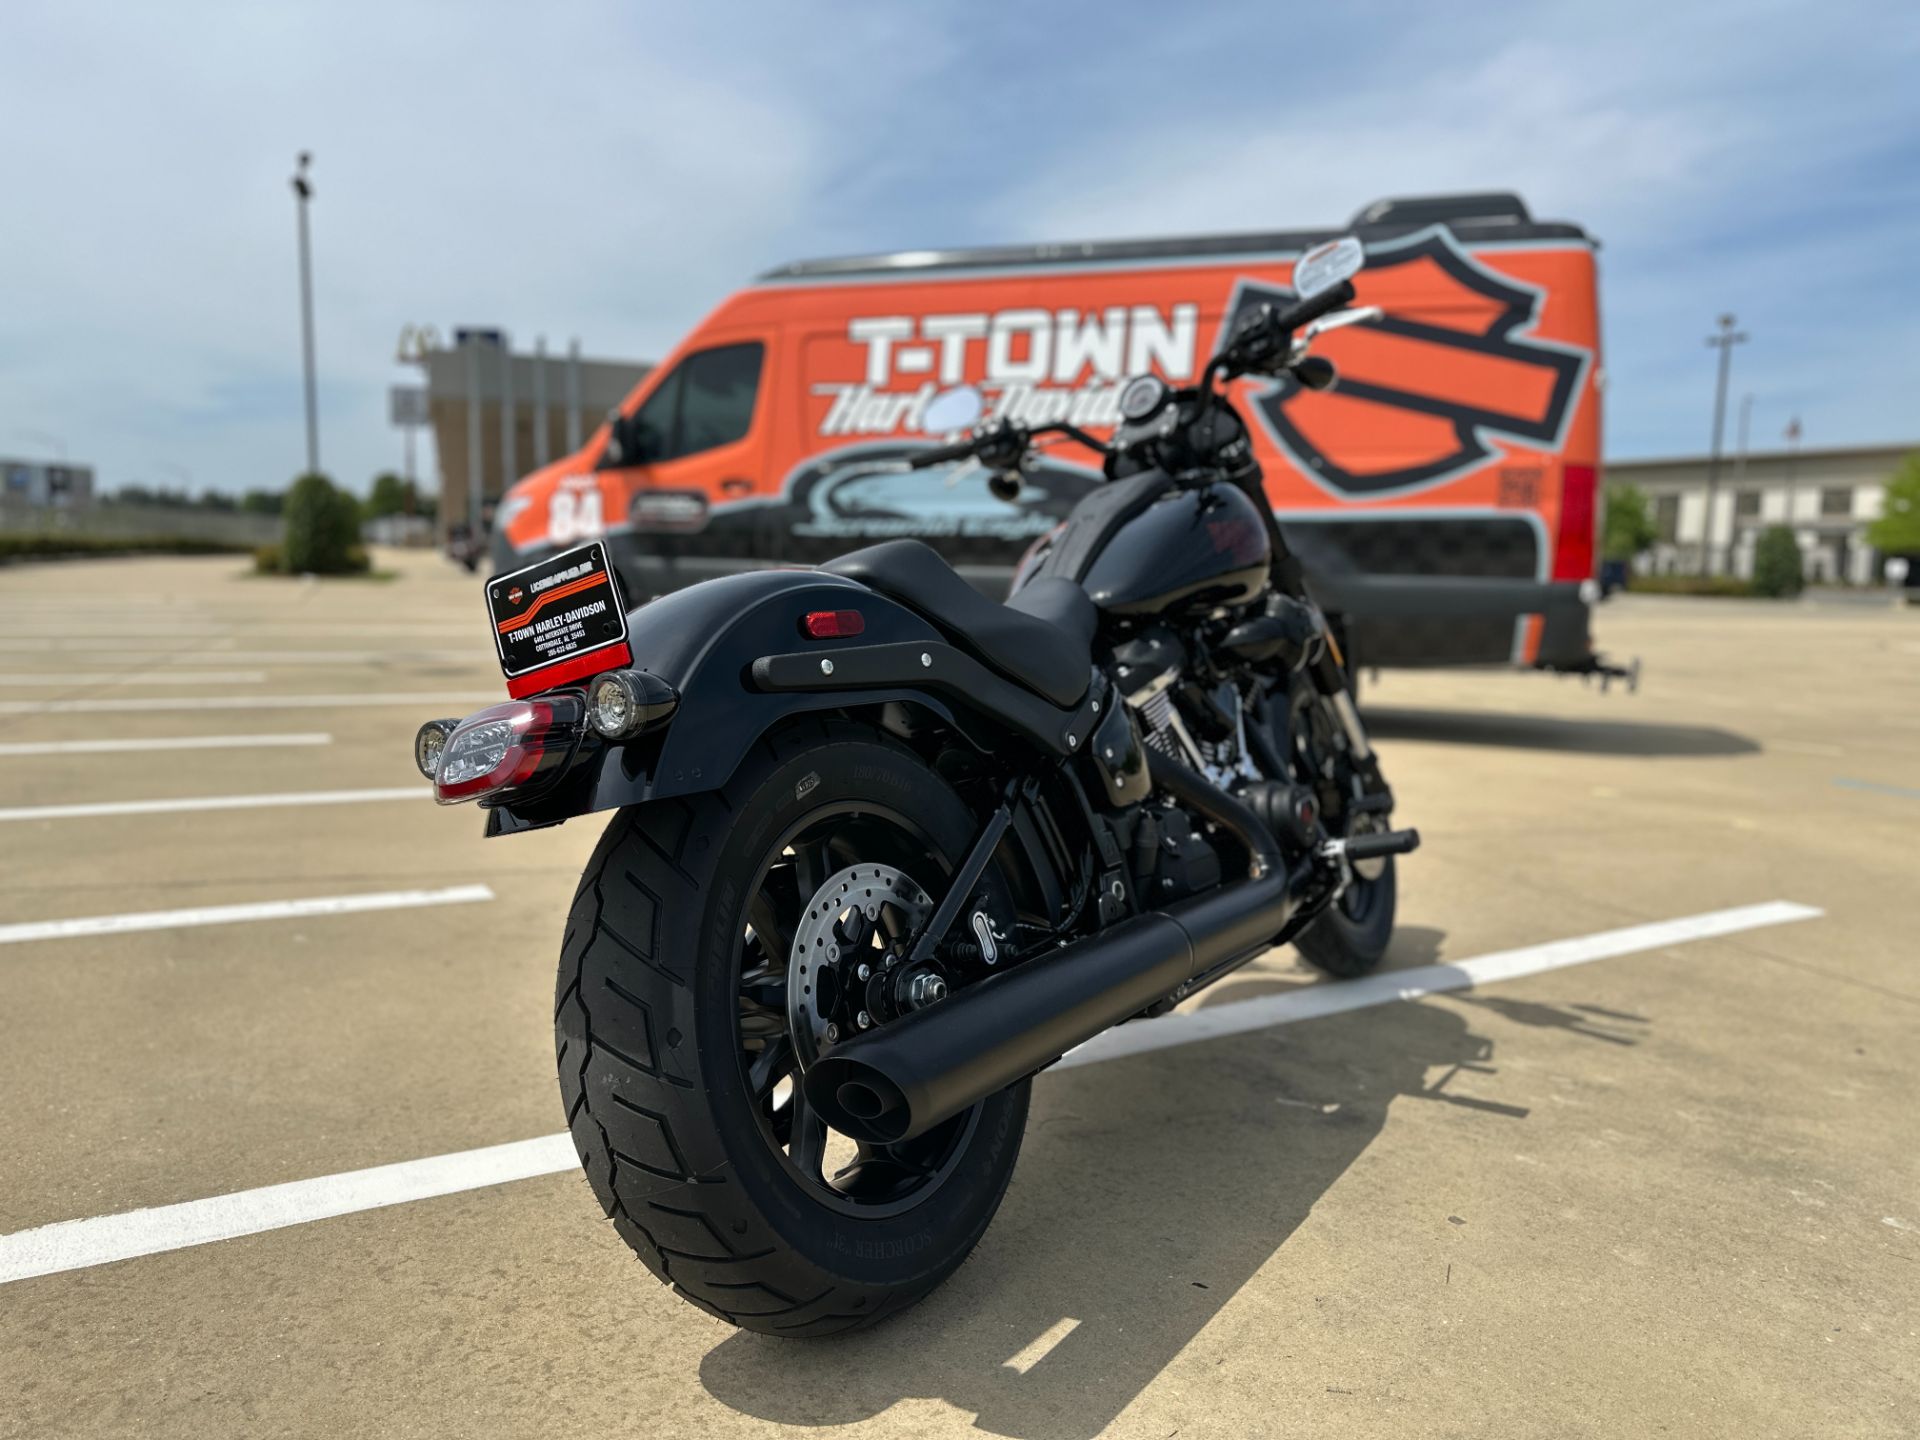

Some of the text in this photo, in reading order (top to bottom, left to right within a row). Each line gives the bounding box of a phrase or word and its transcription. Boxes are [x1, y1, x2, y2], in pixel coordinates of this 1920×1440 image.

[850, 303, 1198, 387] T-TOWN
[508, 600, 606, 643] T-TOWN HARLEY-DAVIDSON
